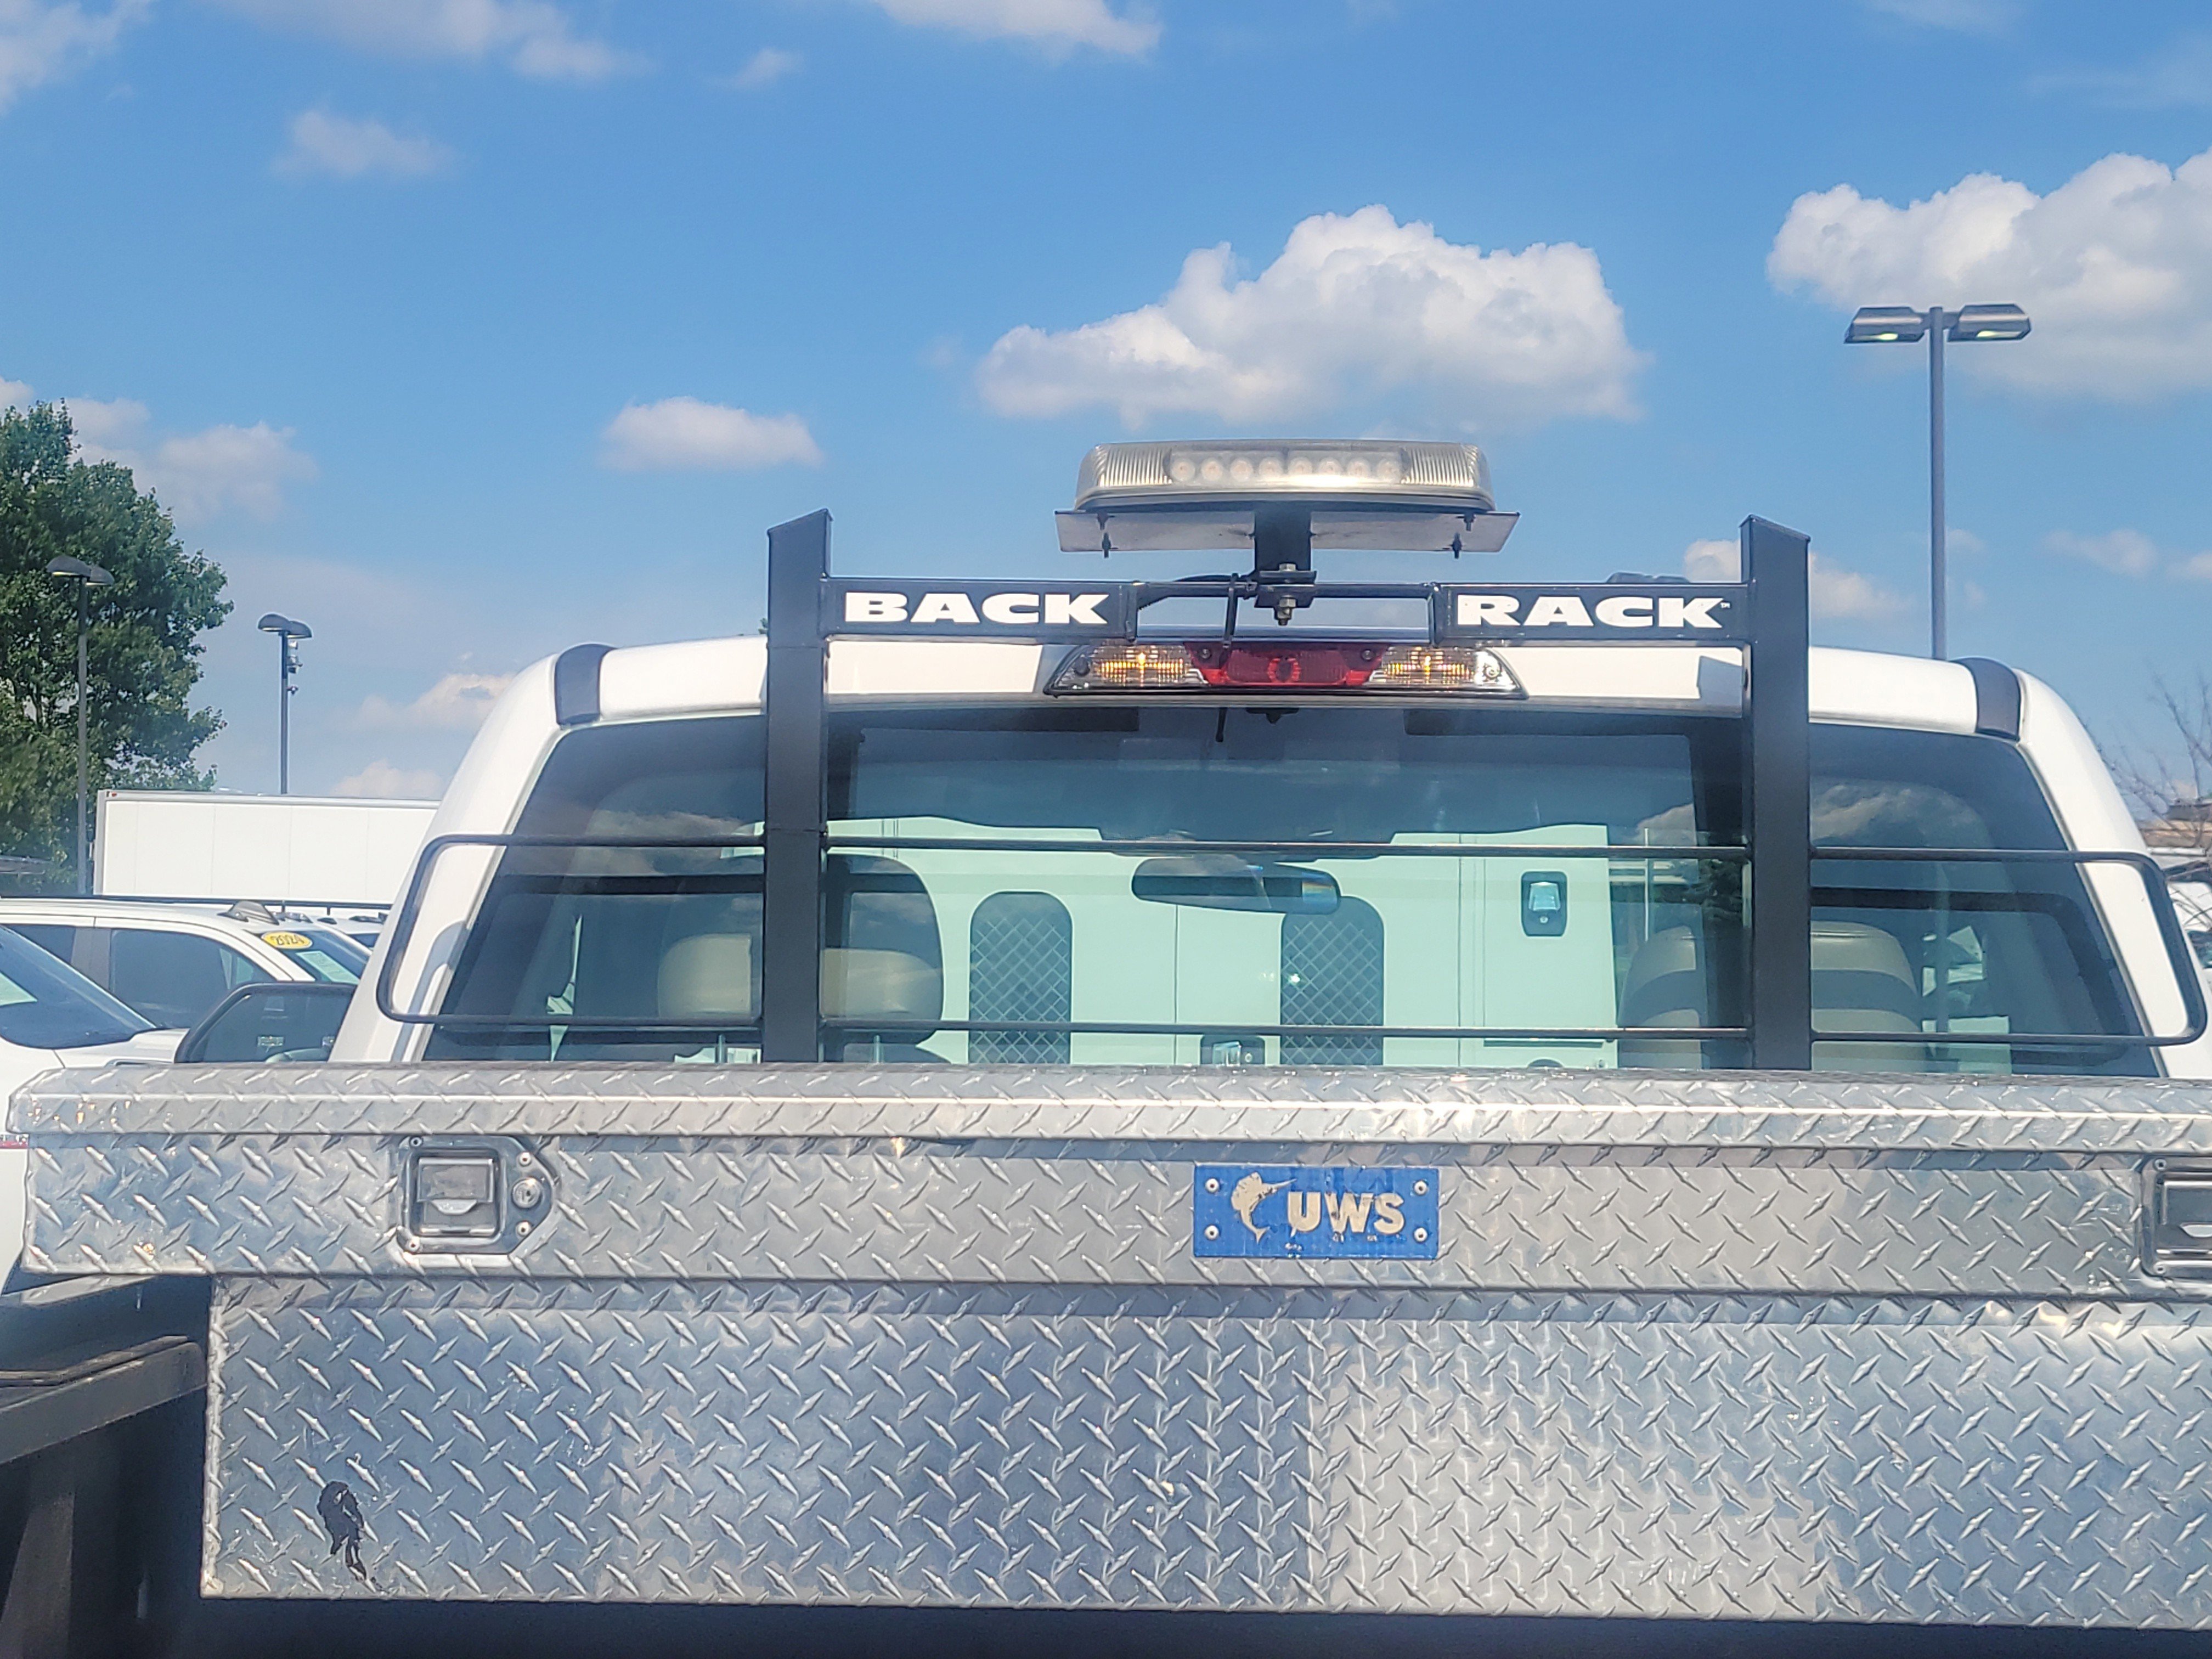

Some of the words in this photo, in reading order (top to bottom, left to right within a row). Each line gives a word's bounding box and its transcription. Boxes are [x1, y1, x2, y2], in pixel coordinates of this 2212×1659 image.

[845, 591, 1109, 624] BACK
[1457, 594, 1724, 628] RACK
[270, 934, 305, 946] 2024
[1286, 1191, 1405, 1235] UWS
